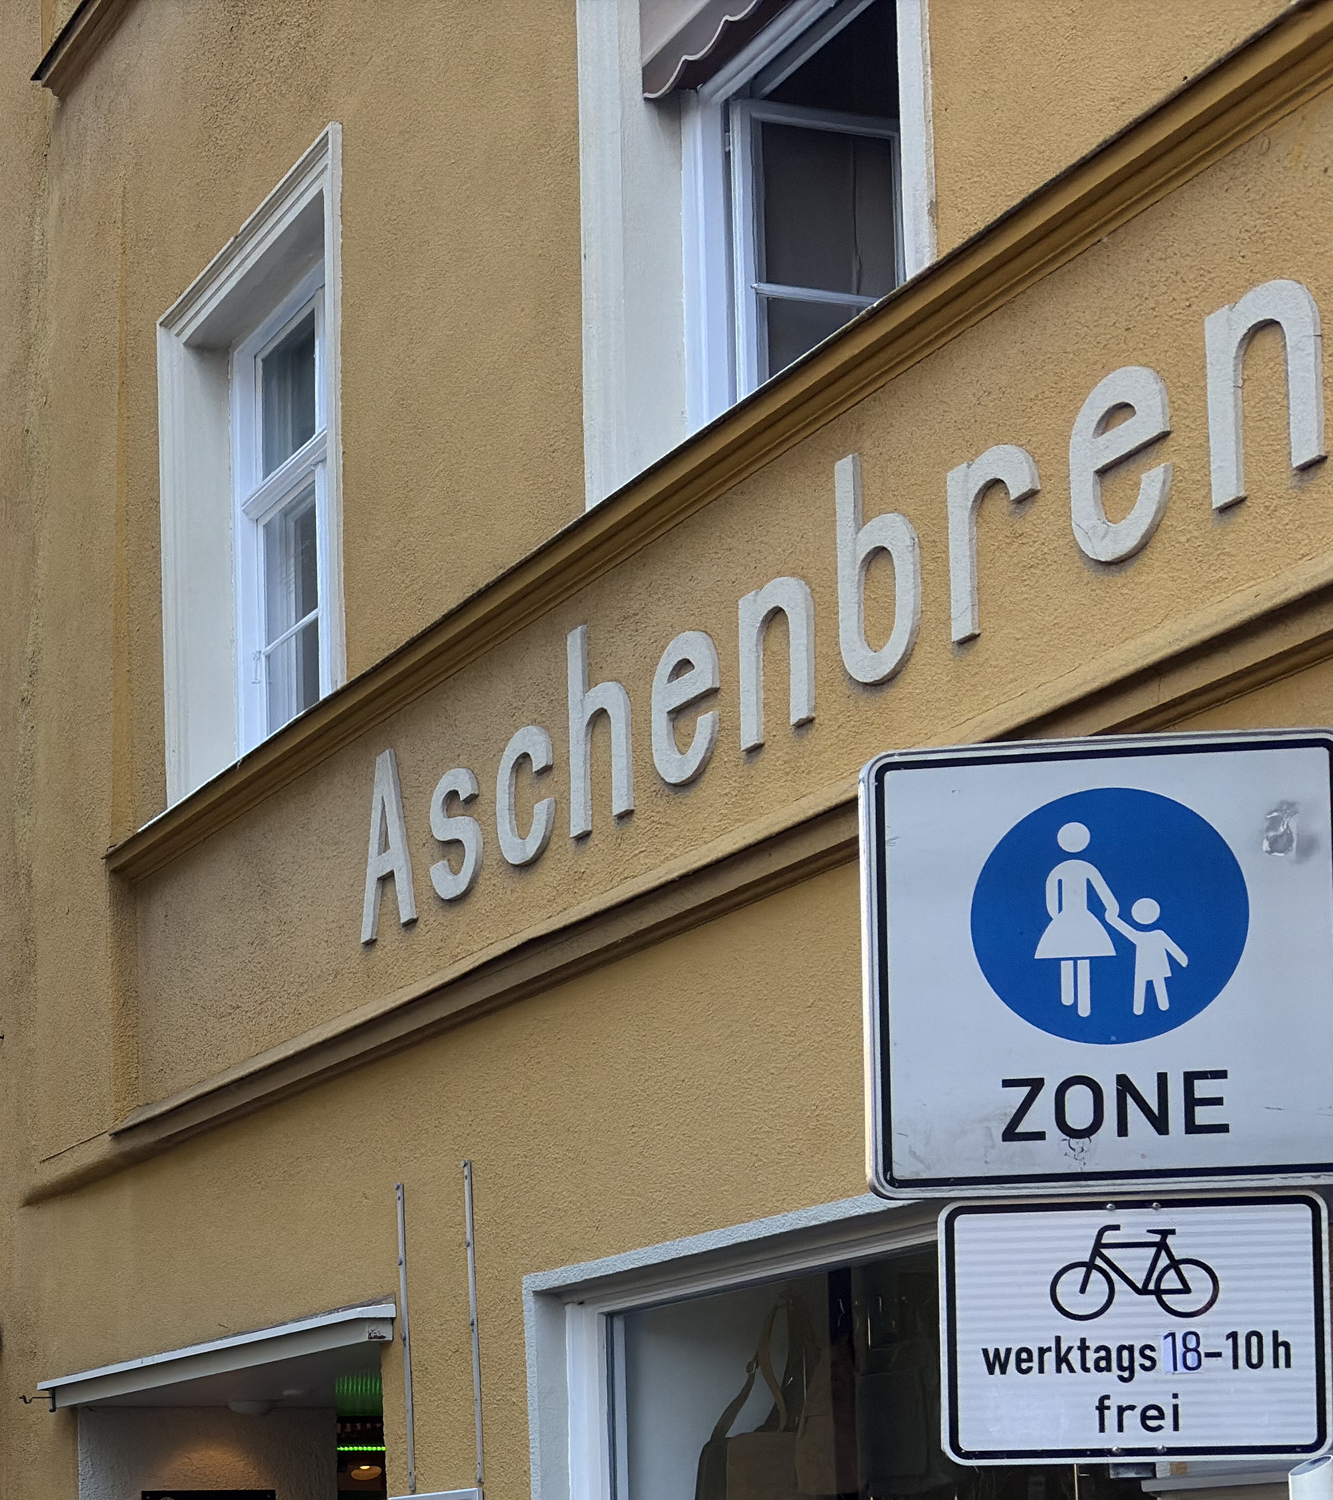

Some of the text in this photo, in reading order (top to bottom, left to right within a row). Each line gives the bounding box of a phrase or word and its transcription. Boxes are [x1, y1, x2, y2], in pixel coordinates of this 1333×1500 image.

[359, 277, 1329, 946] Aschenbren
[1000, 1069, 1231, 1143] ZONE
[982, 1336, 1157, 1383] werktags
[1095, 1393, 1180, 1433] frei
